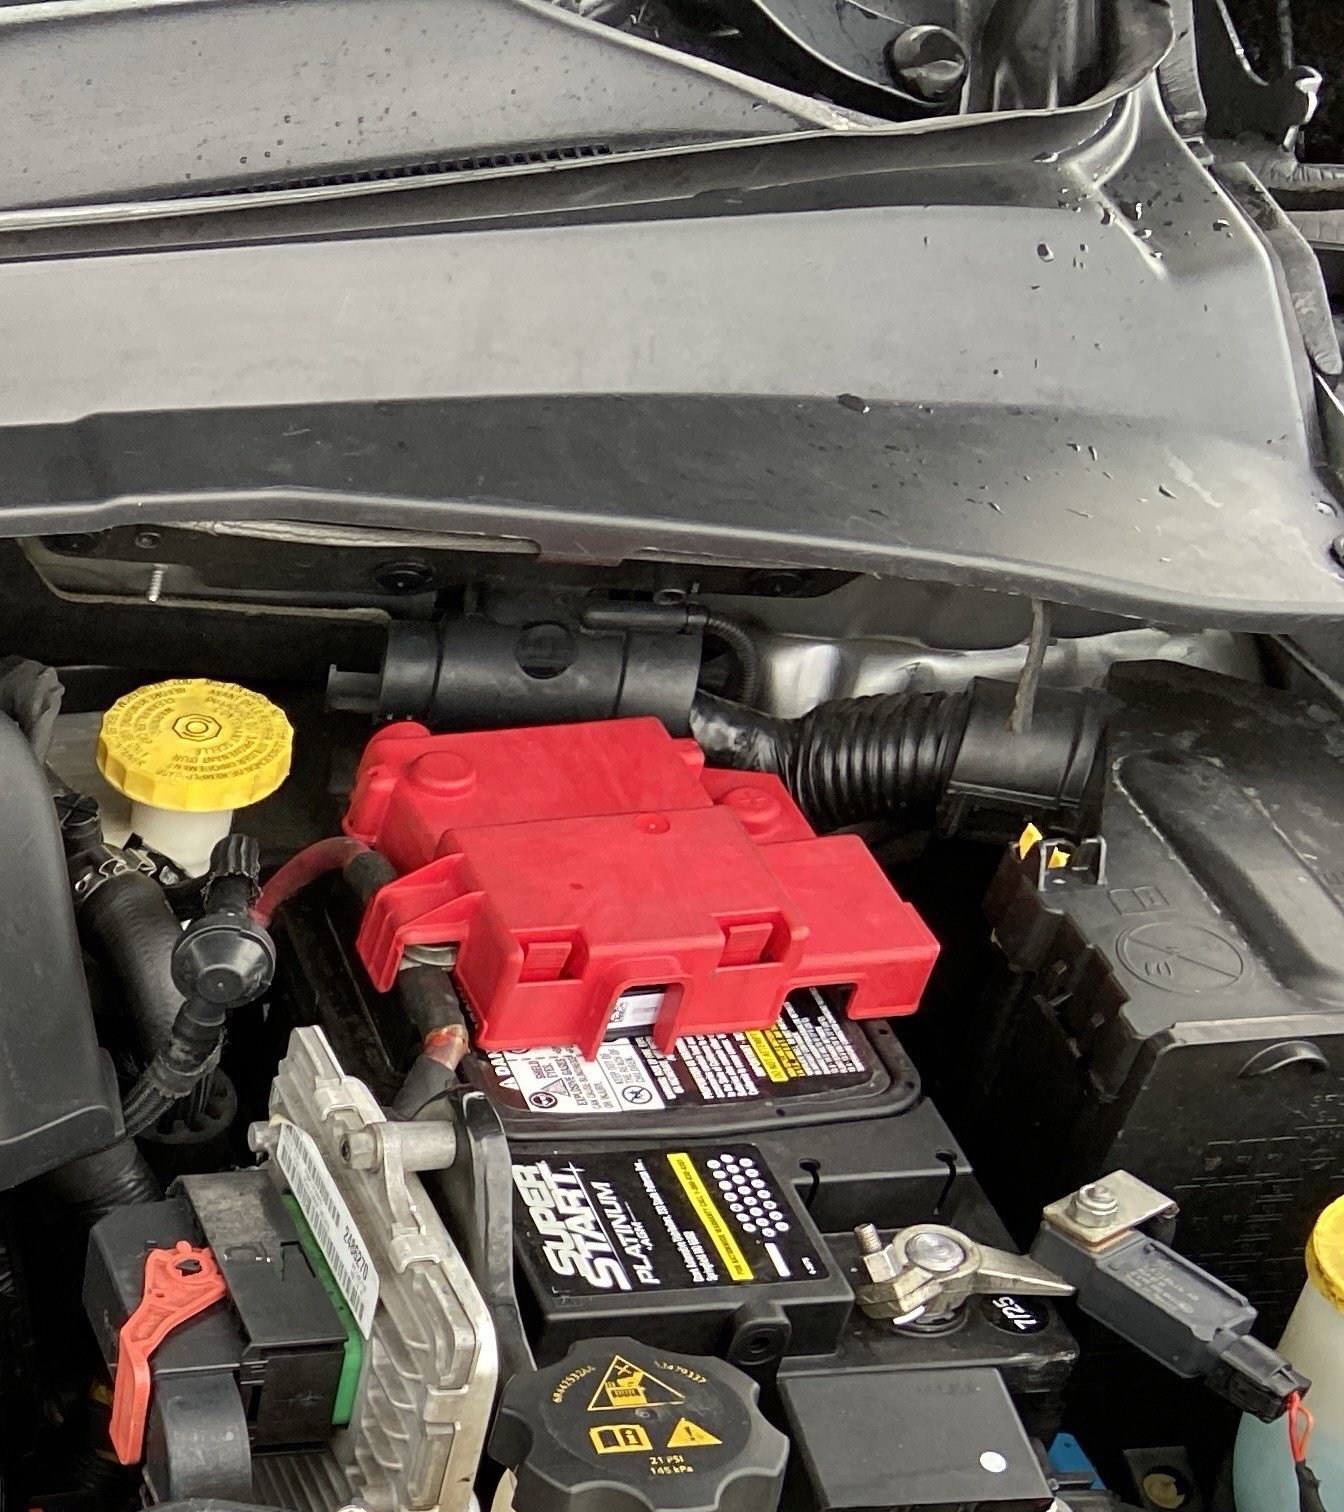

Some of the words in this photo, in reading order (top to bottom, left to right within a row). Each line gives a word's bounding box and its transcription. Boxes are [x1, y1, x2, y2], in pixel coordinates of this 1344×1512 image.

[512, 1164, 574, 1276] SUPER
[536, 1160, 633, 1290] START
[591, 1181, 660, 1285] PLATINUM
